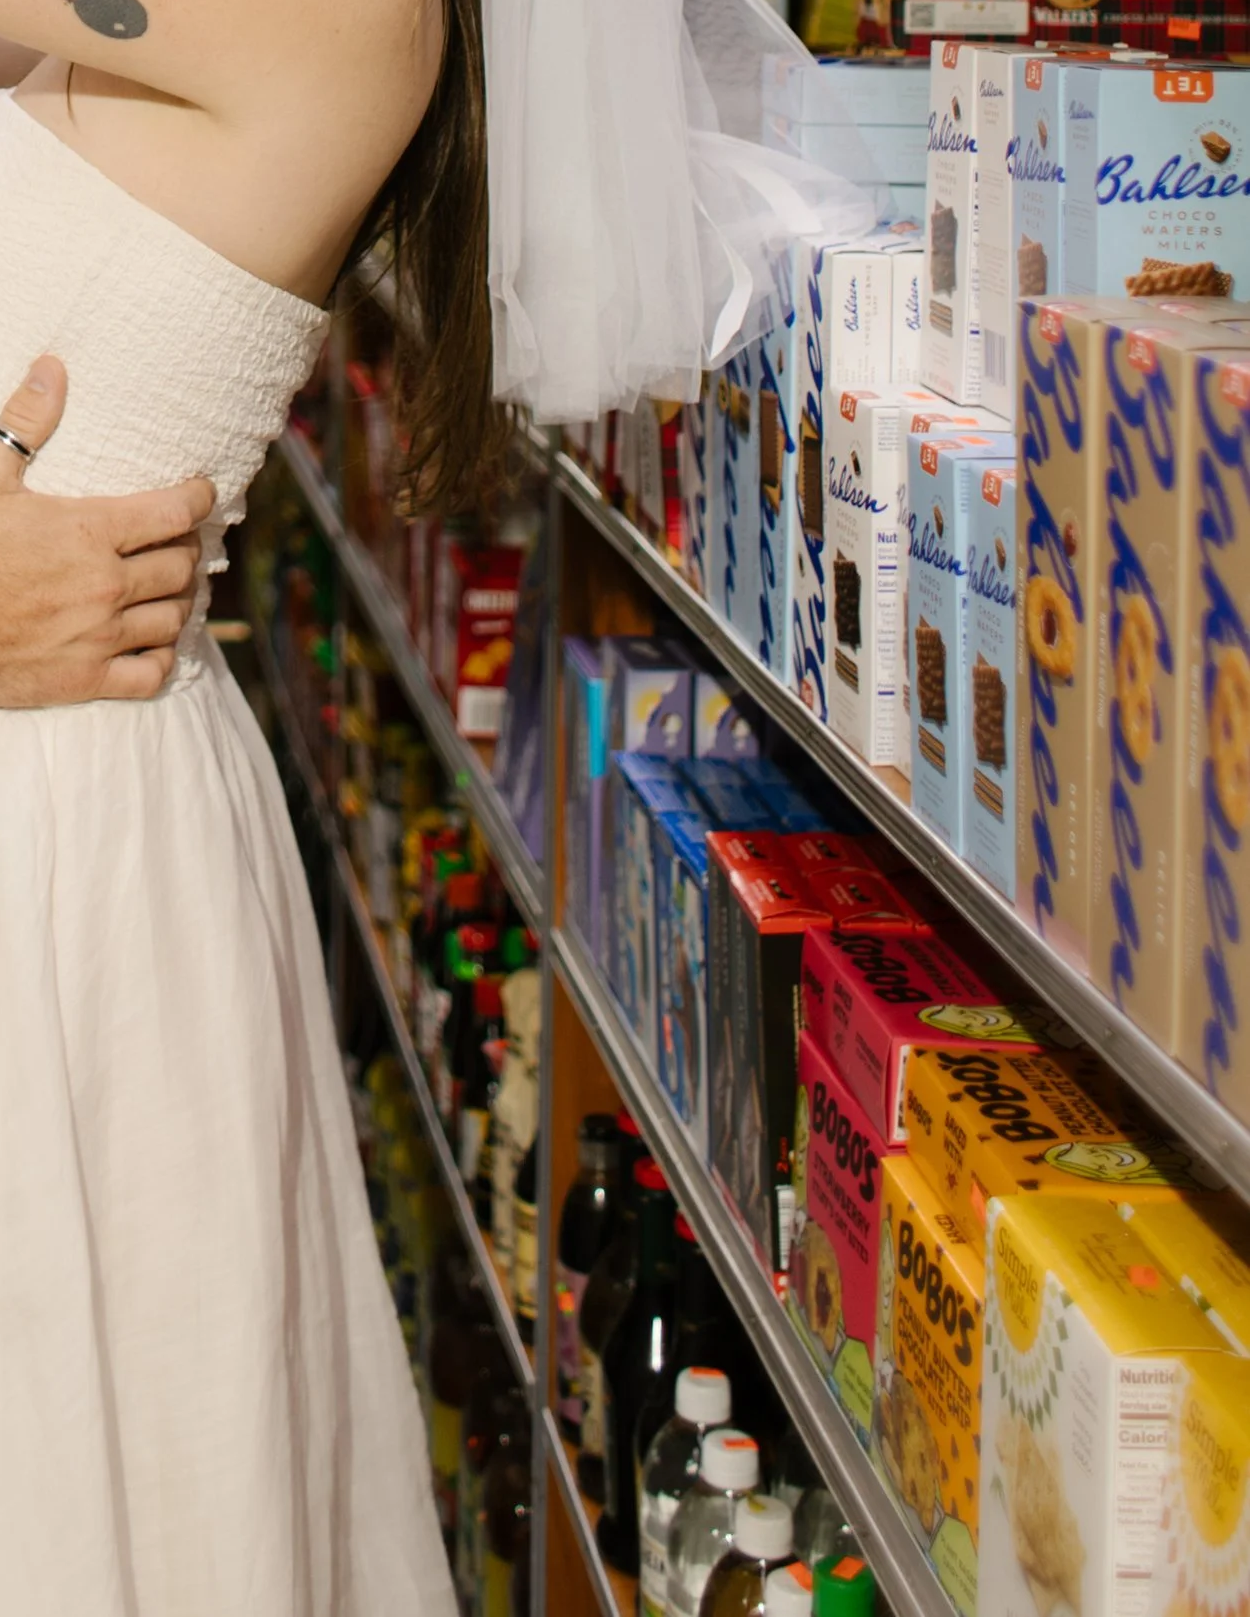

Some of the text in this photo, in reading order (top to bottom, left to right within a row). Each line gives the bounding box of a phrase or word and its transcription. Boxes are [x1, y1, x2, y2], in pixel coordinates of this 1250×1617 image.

[1033, 6, 1099, 27] WALKER'S
[1163, 75, 1205, 96] TET
[927, 110, 979, 154] Bahlsen
[1005, 135, 1066, 183] Bahlsen
[1141, 225, 1223, 236] WAFERS
[1148, 210, 1217, 221] CHOCO
[1158, 240, 1206, 251] MILK
[844, 275, 859, 332] Bahlsen
[905, 275, 921, 331] Bahlsen
[922, 448, 937, 470] TET
[828, 456, 888, 513] Bahlsen
[985, 474, 1000, 498] TET
[908, 513, 968, 575] Bahlsen
[977, 619, 1004, 644] WAFERS
[978, 605, 1001, 627] CHOCO
[981, 635, 998, 654] MILK
[832, 929, 933, 1003] BOBO'S
[937, 1052, 1059, 1142] BOBO'S
[1039, 1092, 1089, 1136] PEANUT
[813, 1080, 879, 1203] BOBO'S
[813, 1150, 871, 1240] STRAWBERRY
[998, 1227, 1038, 1302] Simple
[898, 1220, 975, 1367] BOBO'S
[898, 1318, 945, 1404] CHOCOLATE
[899, 1288, 972, 1412] PEANUT BUTTER
[1118, 1431, 1168, 1445] Calori
[1186, 1400, 1240, 1492] Simple
